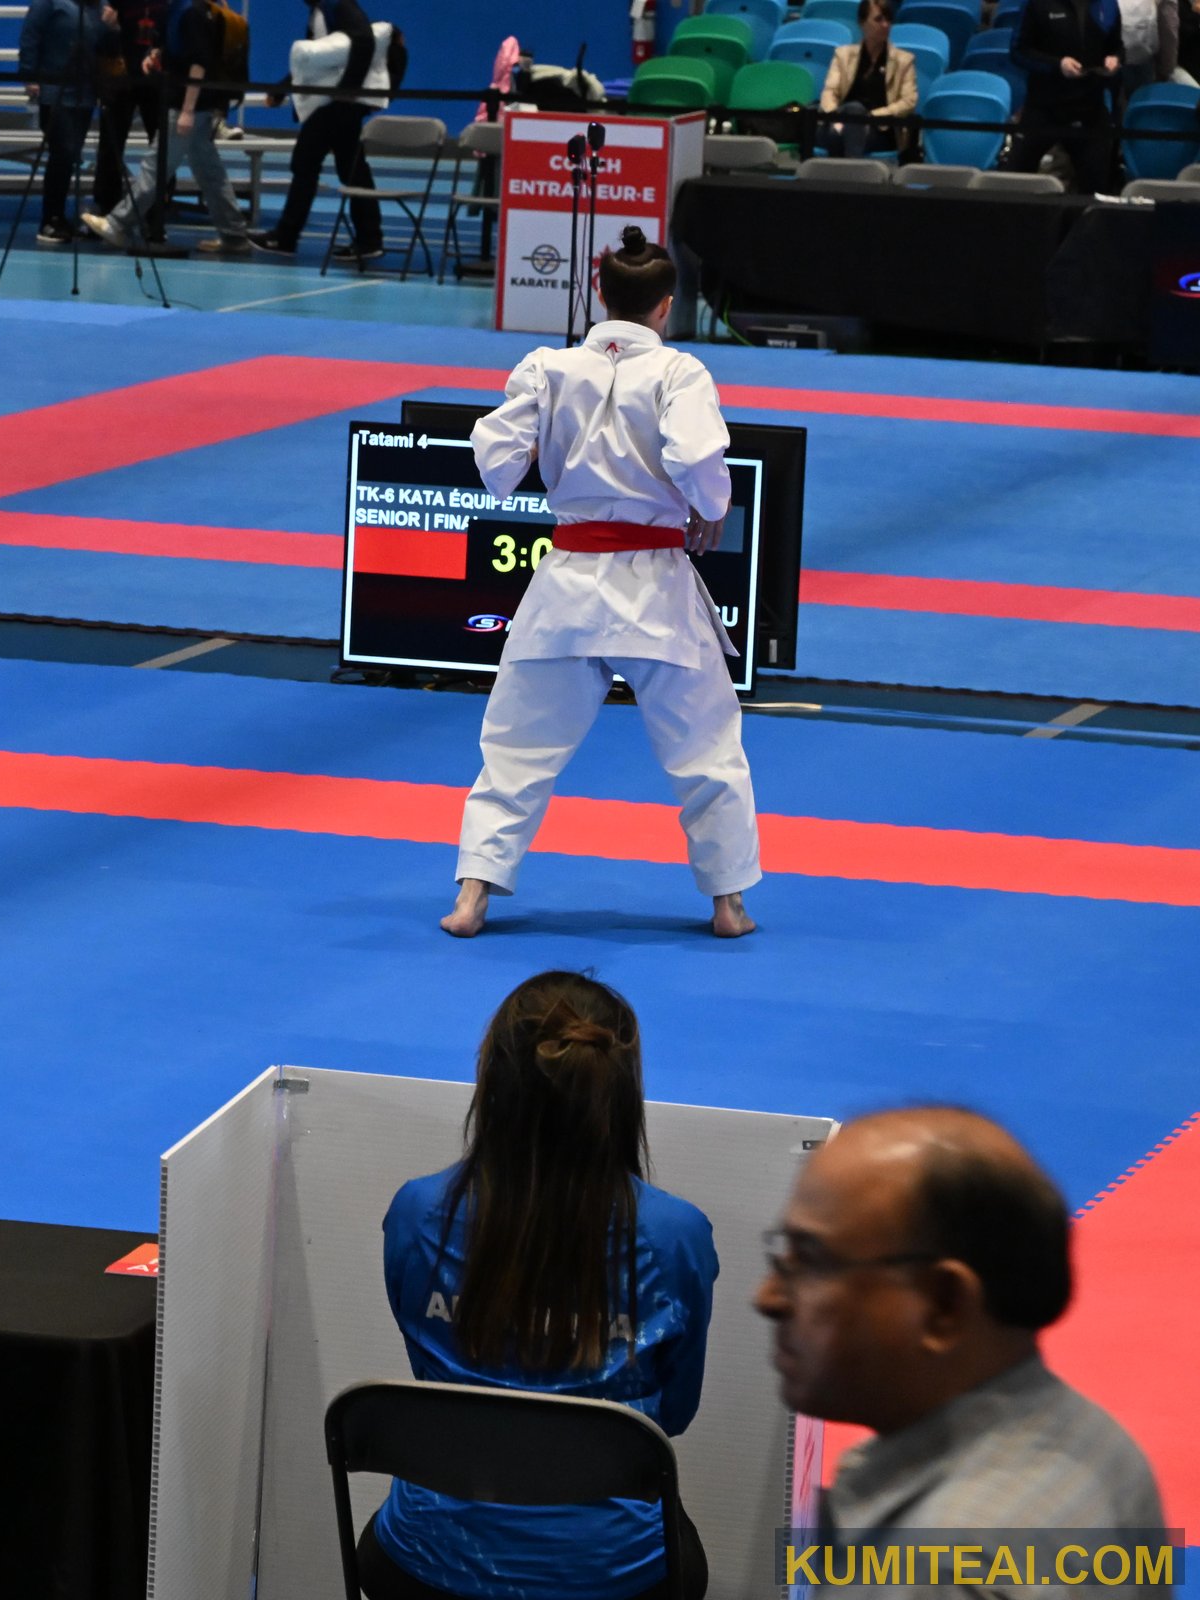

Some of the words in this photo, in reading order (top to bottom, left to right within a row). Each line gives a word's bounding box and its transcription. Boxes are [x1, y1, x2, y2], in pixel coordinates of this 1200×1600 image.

[549, 155, 622, 174] COCH
[508, 178, 656, 203] ENTRANEUR·E
[510, 276, 560, 290] KARATE
[358, 430, 414, 449] Tatami
[417, 434, 429, 450] 4
[356, 486, 395, 504] TK-6
[399, 488, 446, 507] KATA
[355, 508, 421, 528] SENIOR
[433, 513, 479, 531] FINA
